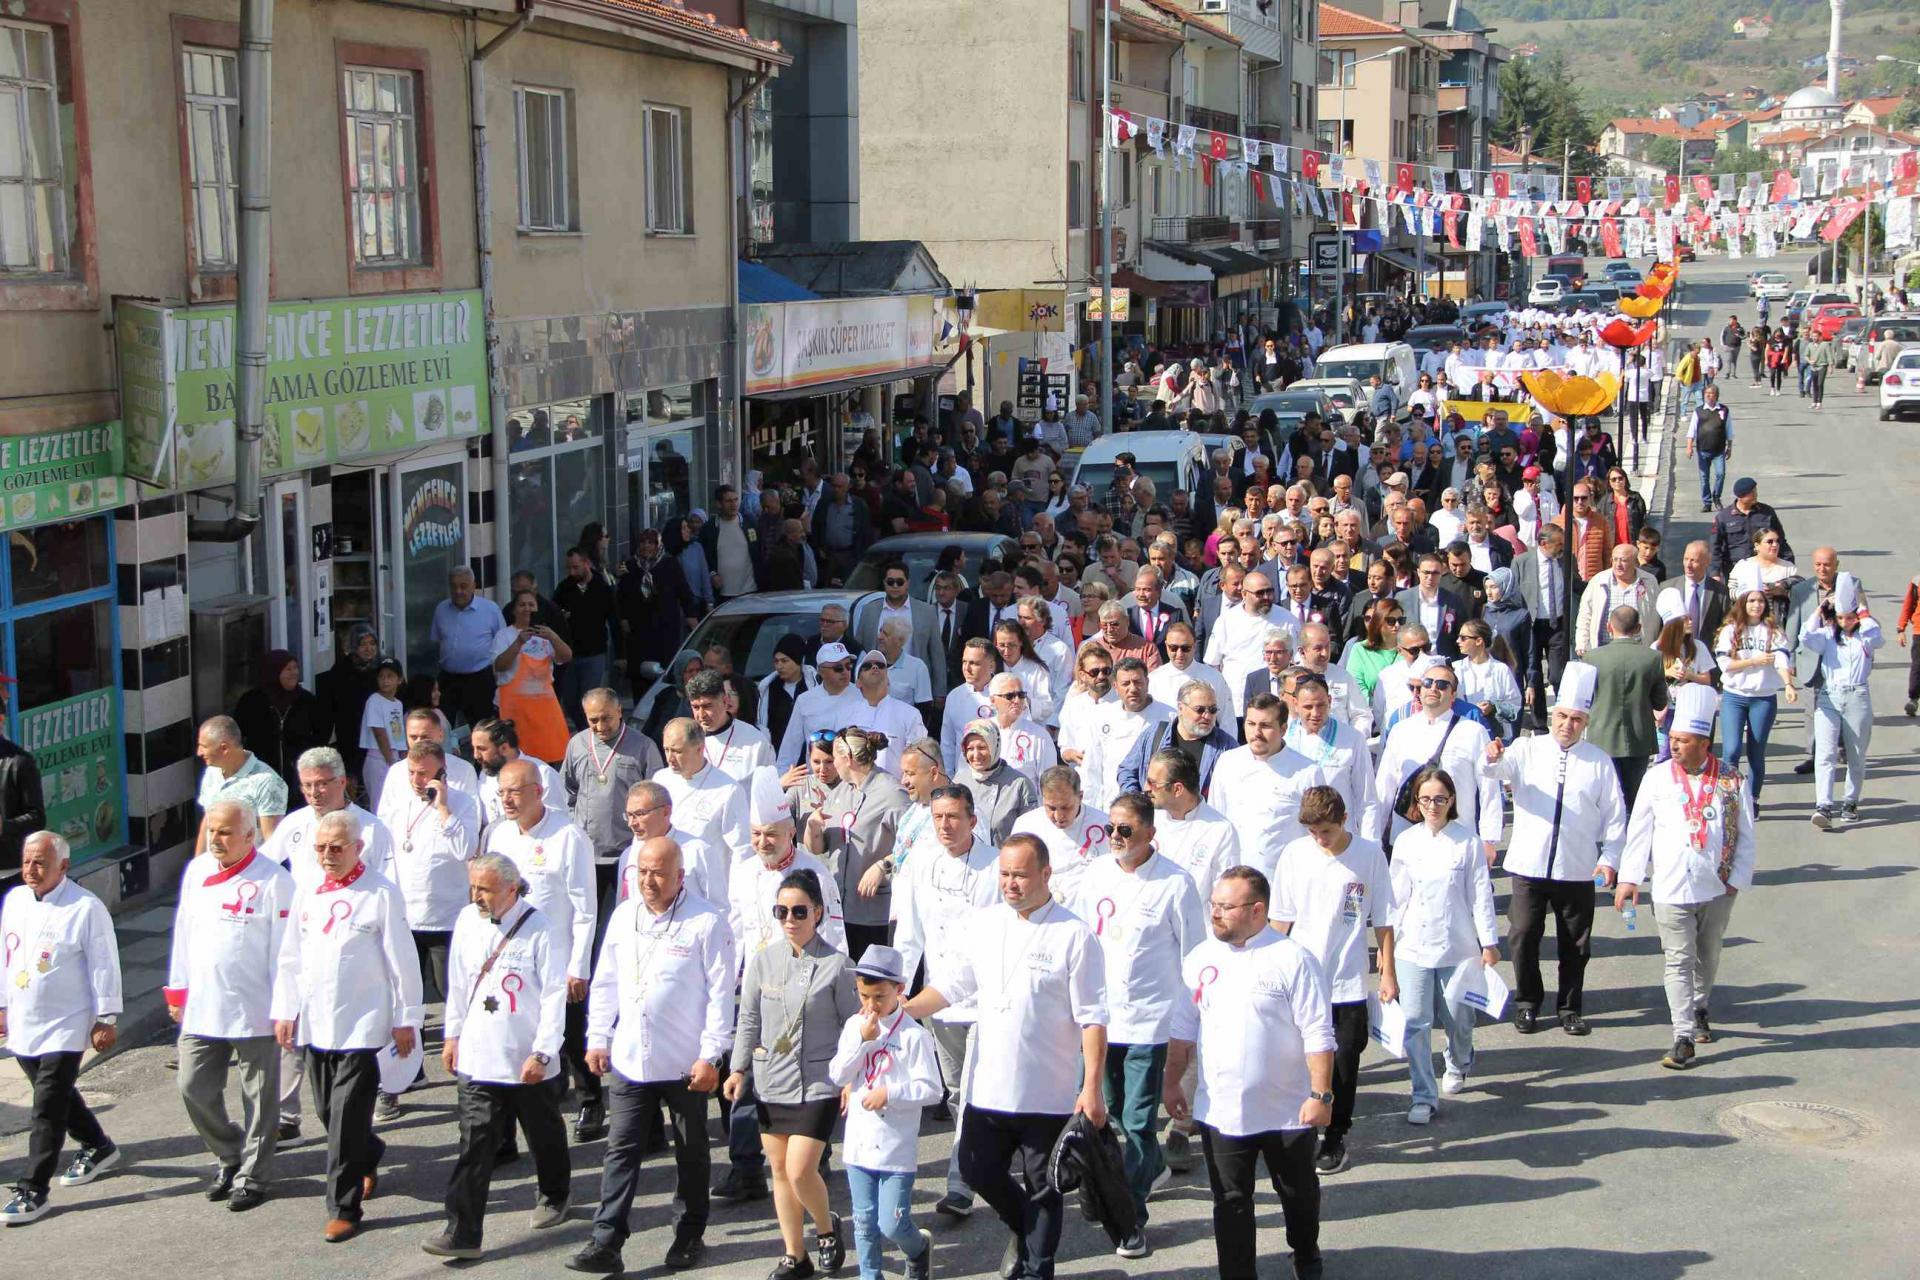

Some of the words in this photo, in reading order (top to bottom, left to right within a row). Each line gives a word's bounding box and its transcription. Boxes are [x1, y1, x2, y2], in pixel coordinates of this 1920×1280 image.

[344, 299, 471, 355] LEZZETLER
[830, 320, 858, 355] SÜPER
[860, 321, 896, 352] MARKET
[204, 371, 319, 412] BAAMA
[324, 359, 418, 396] GÖZLEME
[423, 351, 453, 384] EVİ
[18, 425, 113, 468] LEZZETLER
[23, 693, 110, 753] LEZZETLER
